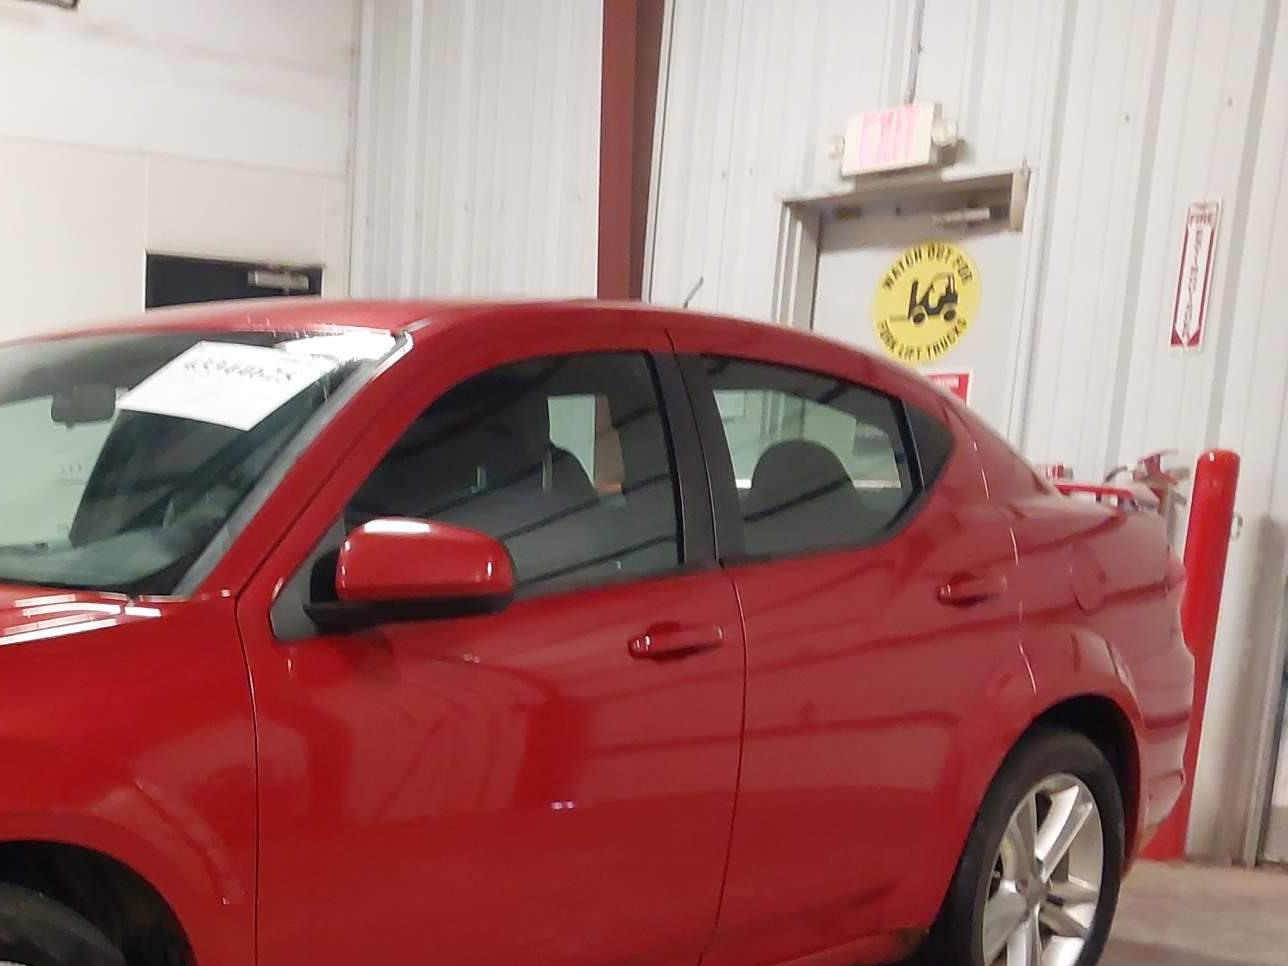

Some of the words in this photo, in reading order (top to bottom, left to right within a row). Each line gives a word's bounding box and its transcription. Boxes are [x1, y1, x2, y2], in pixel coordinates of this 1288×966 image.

[882, 246, 923, 290] WATCH
[927, 242, 953, 264] OUT
[878, 319, 897, 352] FORK
[925, 318, 968, 360] TRUCKS
